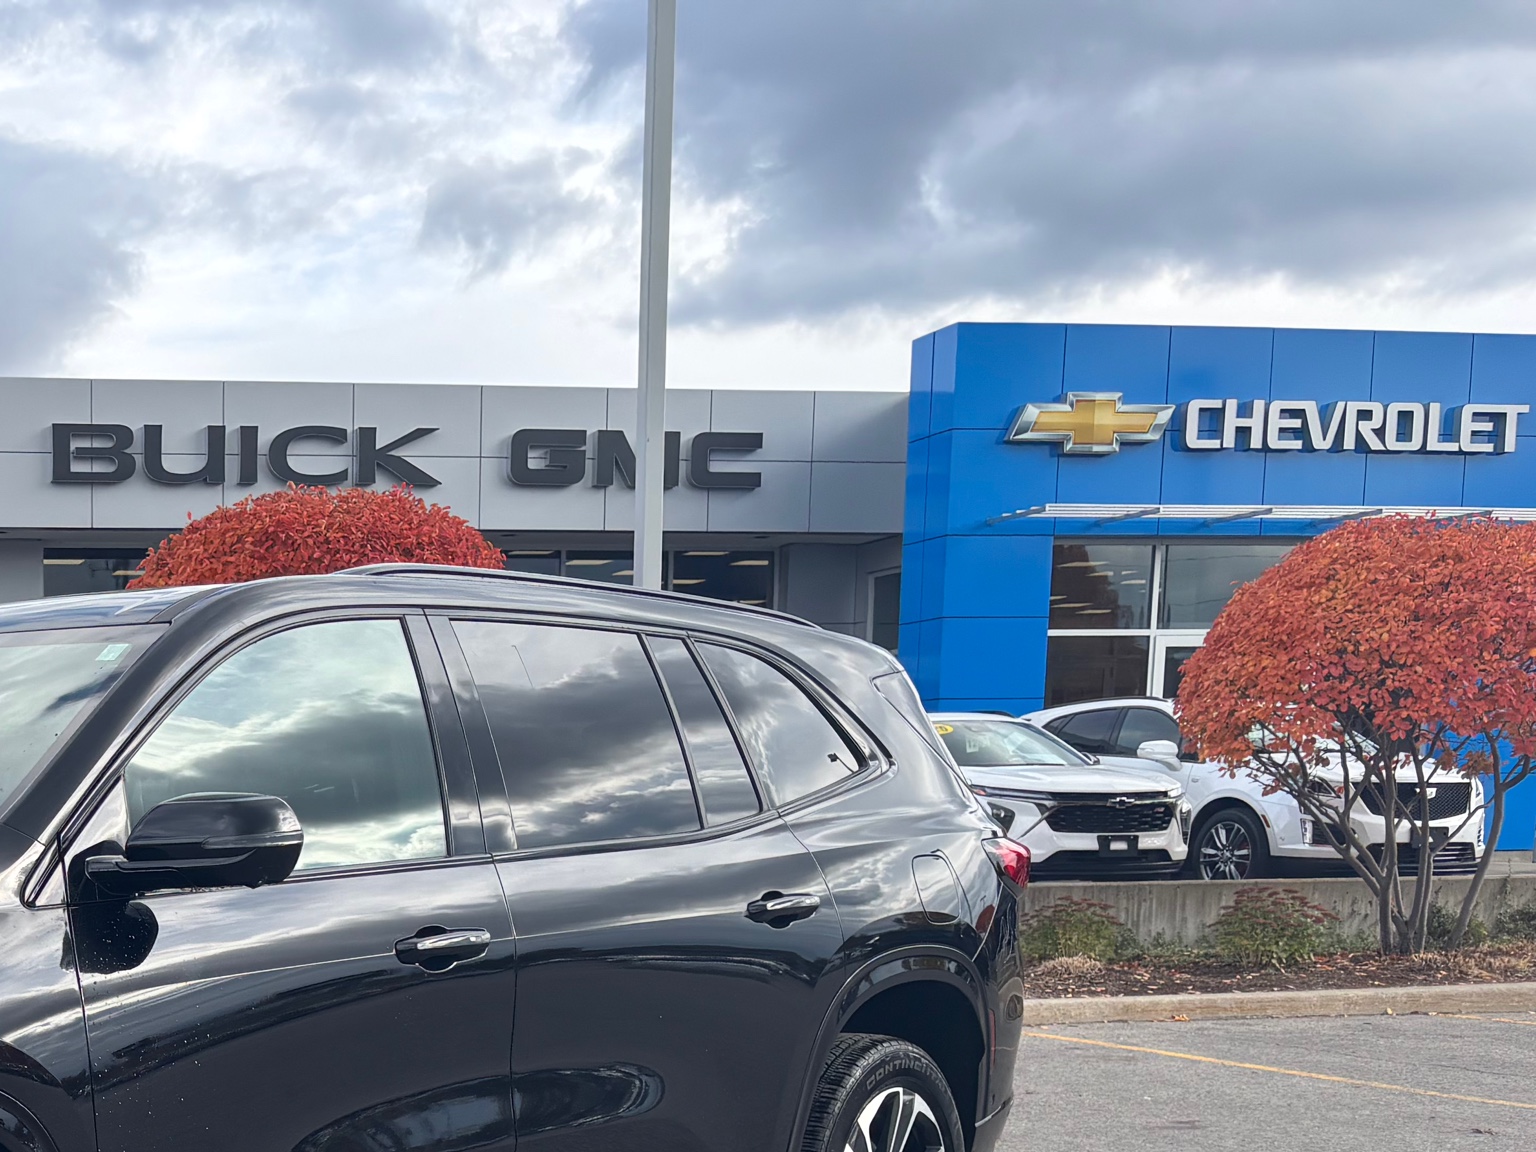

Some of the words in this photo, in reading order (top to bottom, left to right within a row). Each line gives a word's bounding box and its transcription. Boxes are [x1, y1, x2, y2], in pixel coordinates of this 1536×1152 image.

[51, 423, 443, 487] BUICK
[1184, 398, 1531, 453] CHEVROLET
[509, 428, 764, 489] GMC
